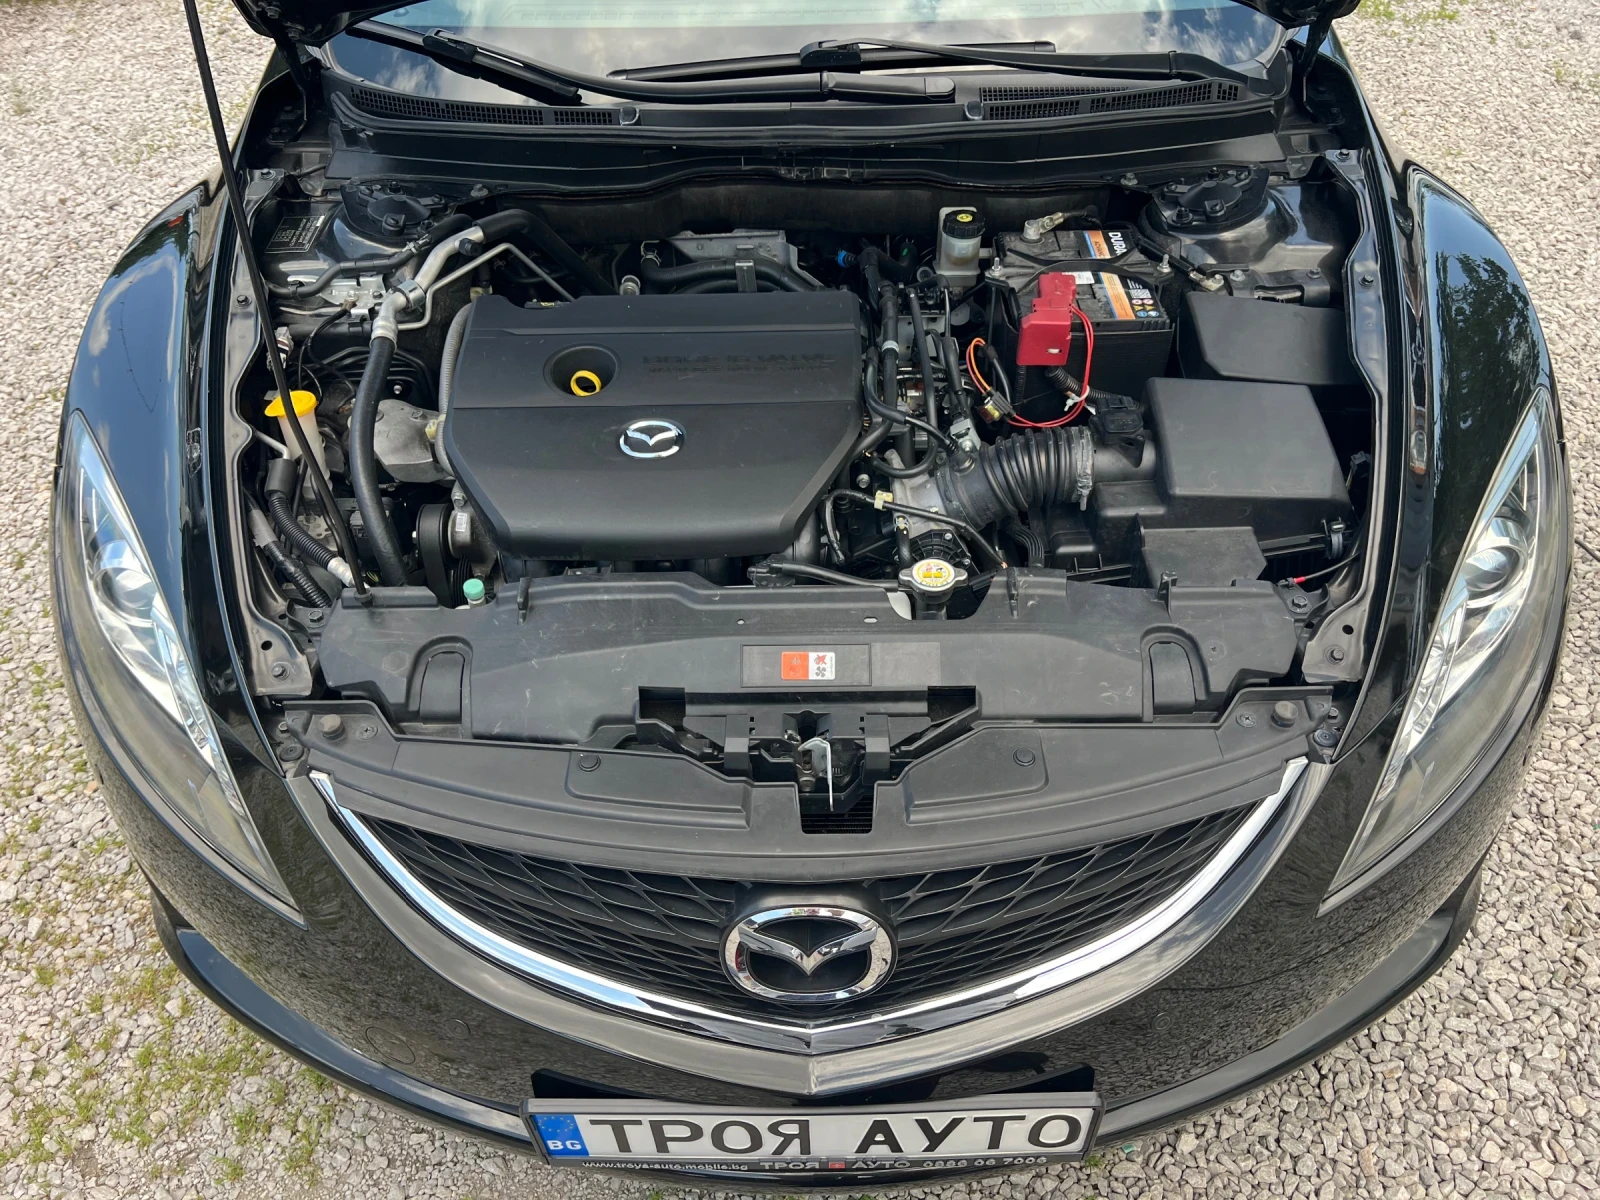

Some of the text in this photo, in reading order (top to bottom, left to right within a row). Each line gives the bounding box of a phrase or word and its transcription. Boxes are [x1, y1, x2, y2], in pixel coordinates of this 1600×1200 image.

[589, 1114, 1082, 1156] ТРОЯ АУТО
[547, 1139, 582, 1150] BG
[760, 1161, 820, 1170] ТРОЯ
[852, 1160, 911, 1169] АУТО
